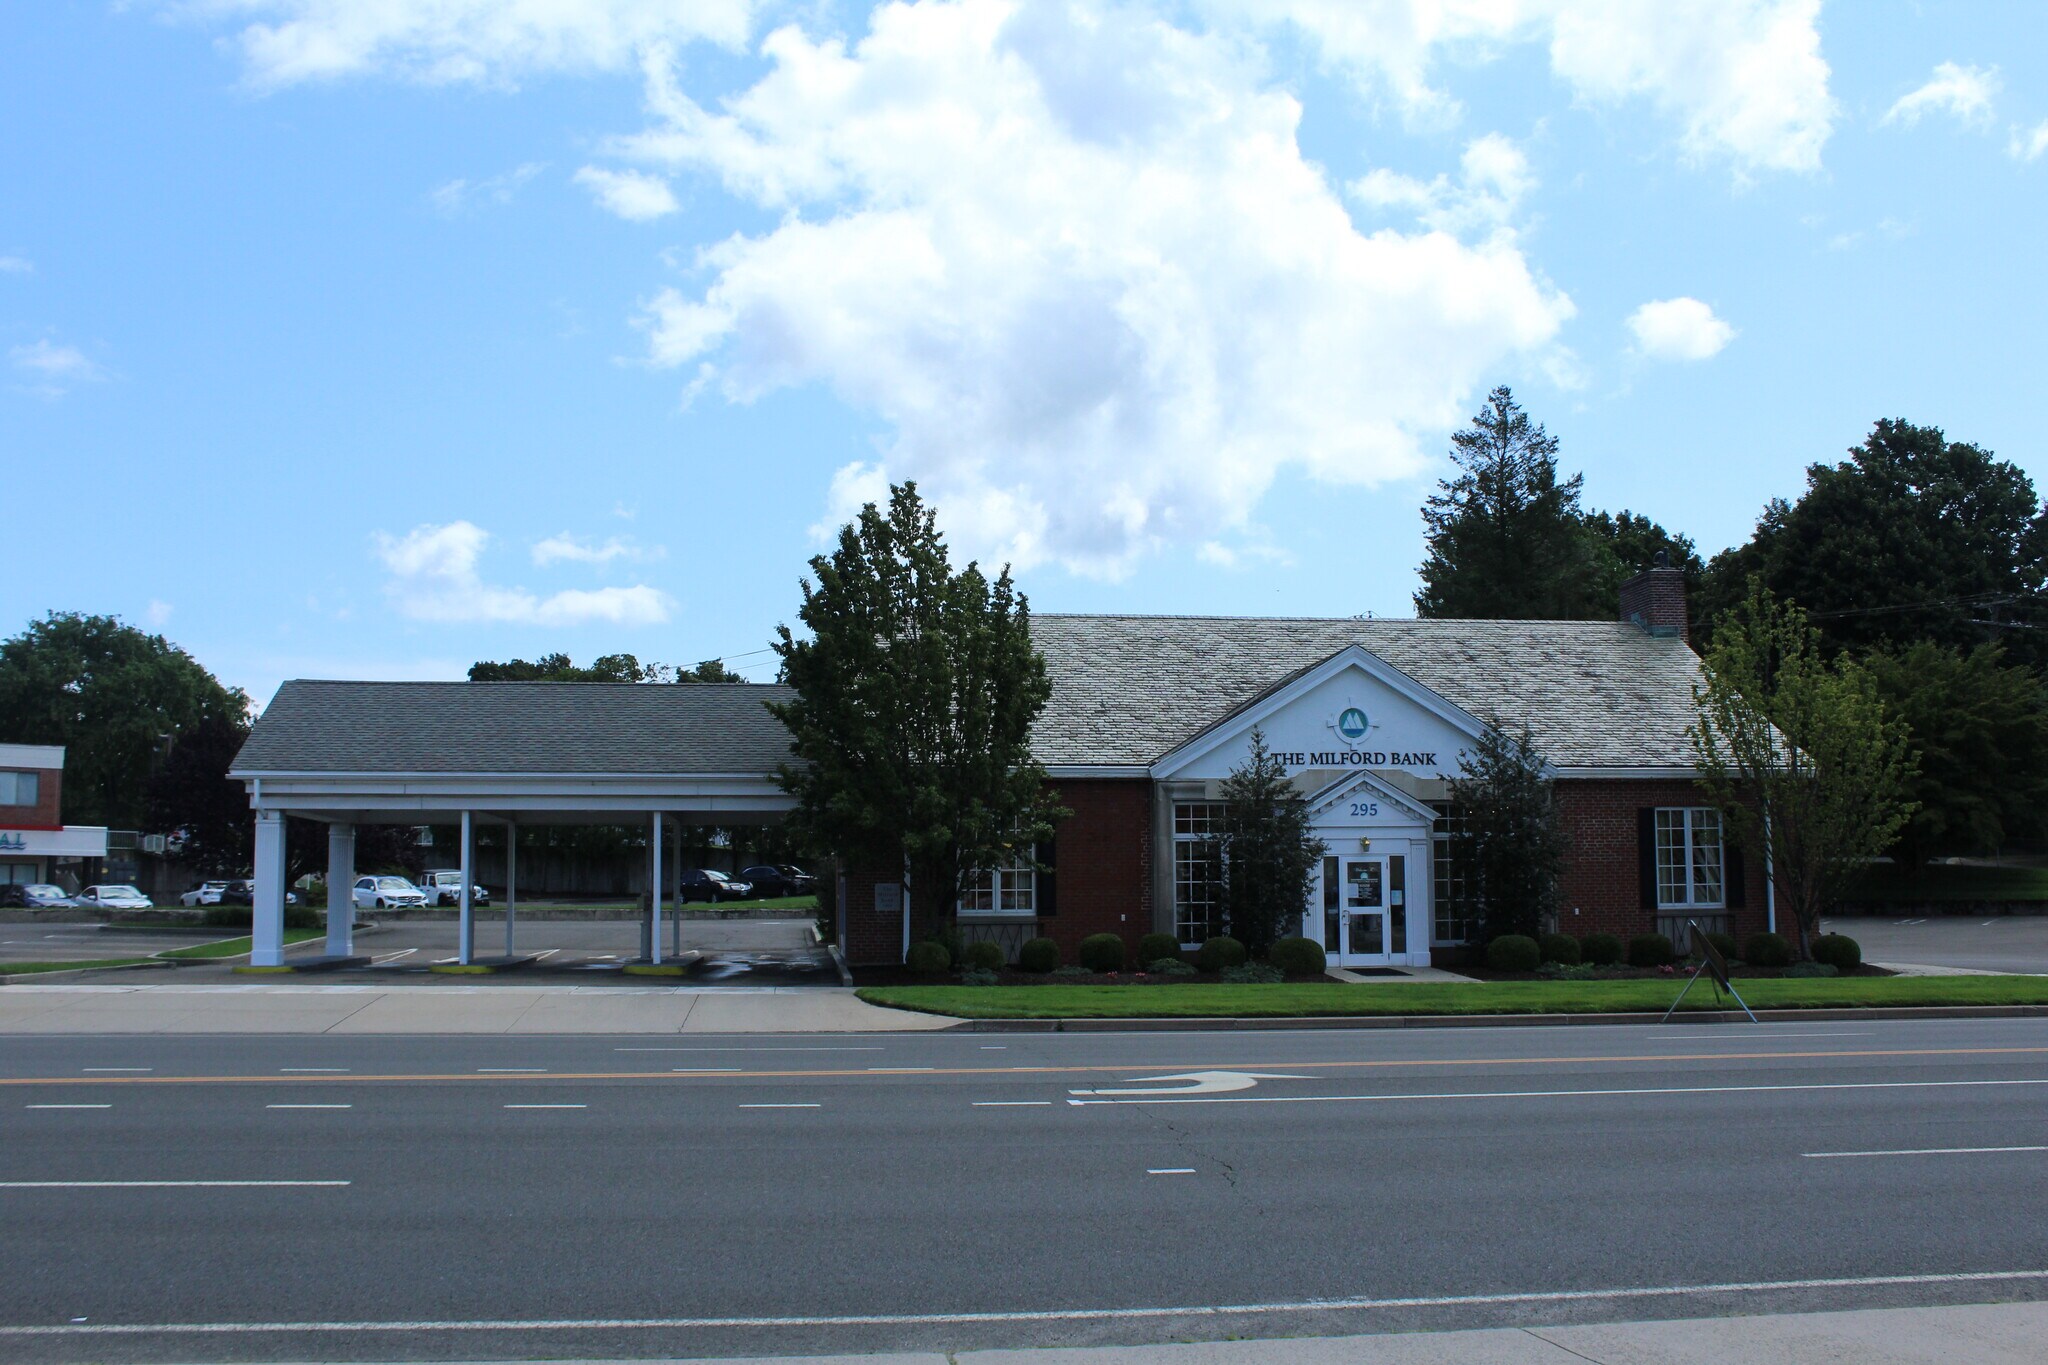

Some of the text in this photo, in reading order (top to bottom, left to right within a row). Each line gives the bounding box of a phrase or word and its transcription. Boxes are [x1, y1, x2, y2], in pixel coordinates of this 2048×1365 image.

[1270, 752, 1438, 766] THE MILFORD BANK
[1350, 803, 1378, 817] 295
